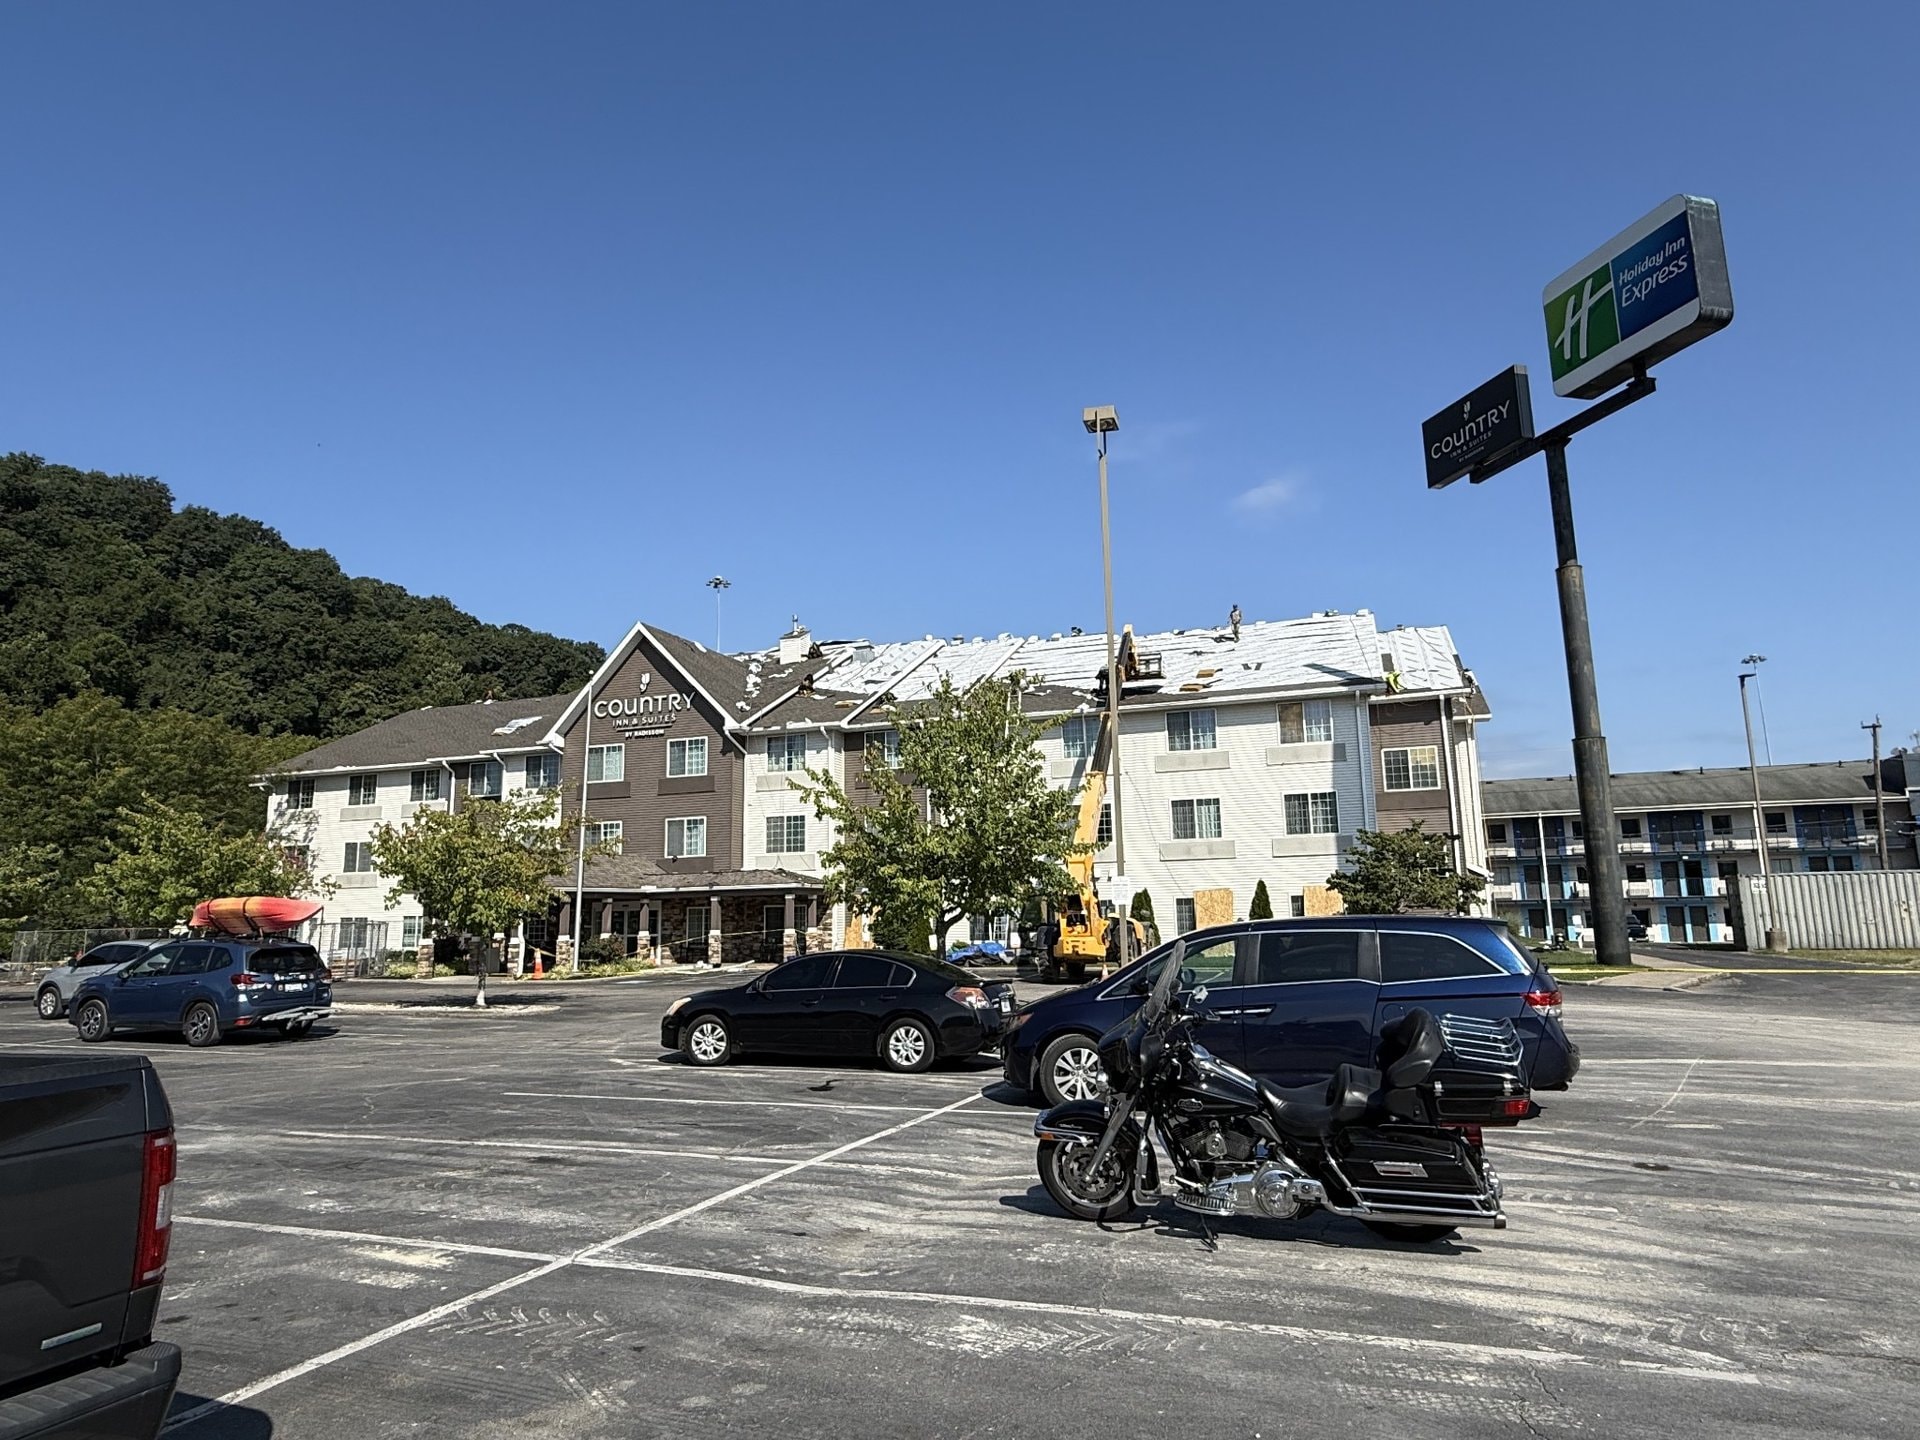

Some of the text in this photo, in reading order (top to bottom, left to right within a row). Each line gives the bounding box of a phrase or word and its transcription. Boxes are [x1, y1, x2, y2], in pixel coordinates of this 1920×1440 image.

[1619, 237, 1685, 285] Holiday Inn
[1621, 254, 1688, 307] Express
[1431, 400, 1510, 459] COUNTRY
[594, 691, 696, 718] COUNTRY
[612, 718, 629, 727] INN
[641, 712, 676, 724] SUITES
